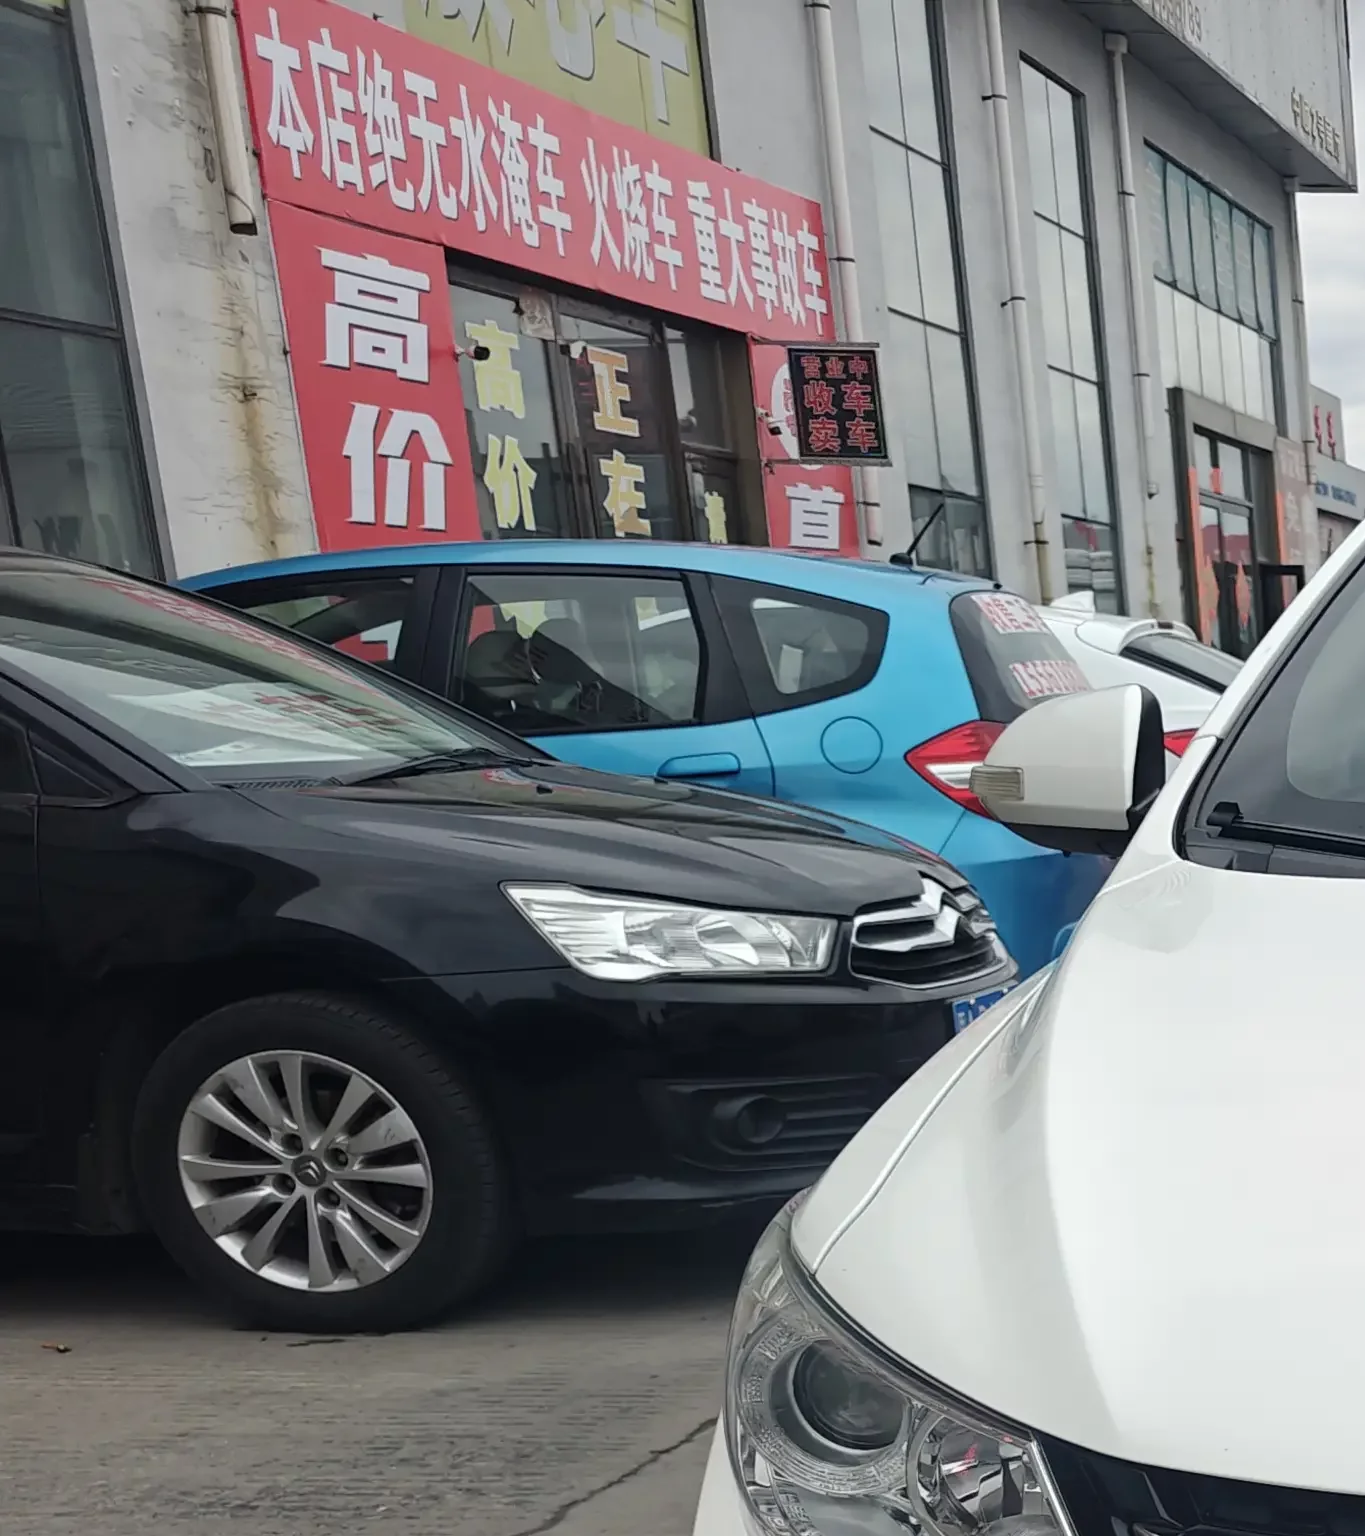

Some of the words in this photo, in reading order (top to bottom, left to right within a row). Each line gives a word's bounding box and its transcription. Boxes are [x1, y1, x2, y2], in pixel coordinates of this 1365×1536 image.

[254, 6, 573, 258] 本店绝无水淹车
[580, 136, 684, 292] 火烧车
[686, 179, 827, 337] 重大事故车
[314, 245, 453, 532] 高价
[464, 319, 538, 532] 高价
[804, 380, 874, 416] 收车
[808, 417, 879, 452] 卖车
